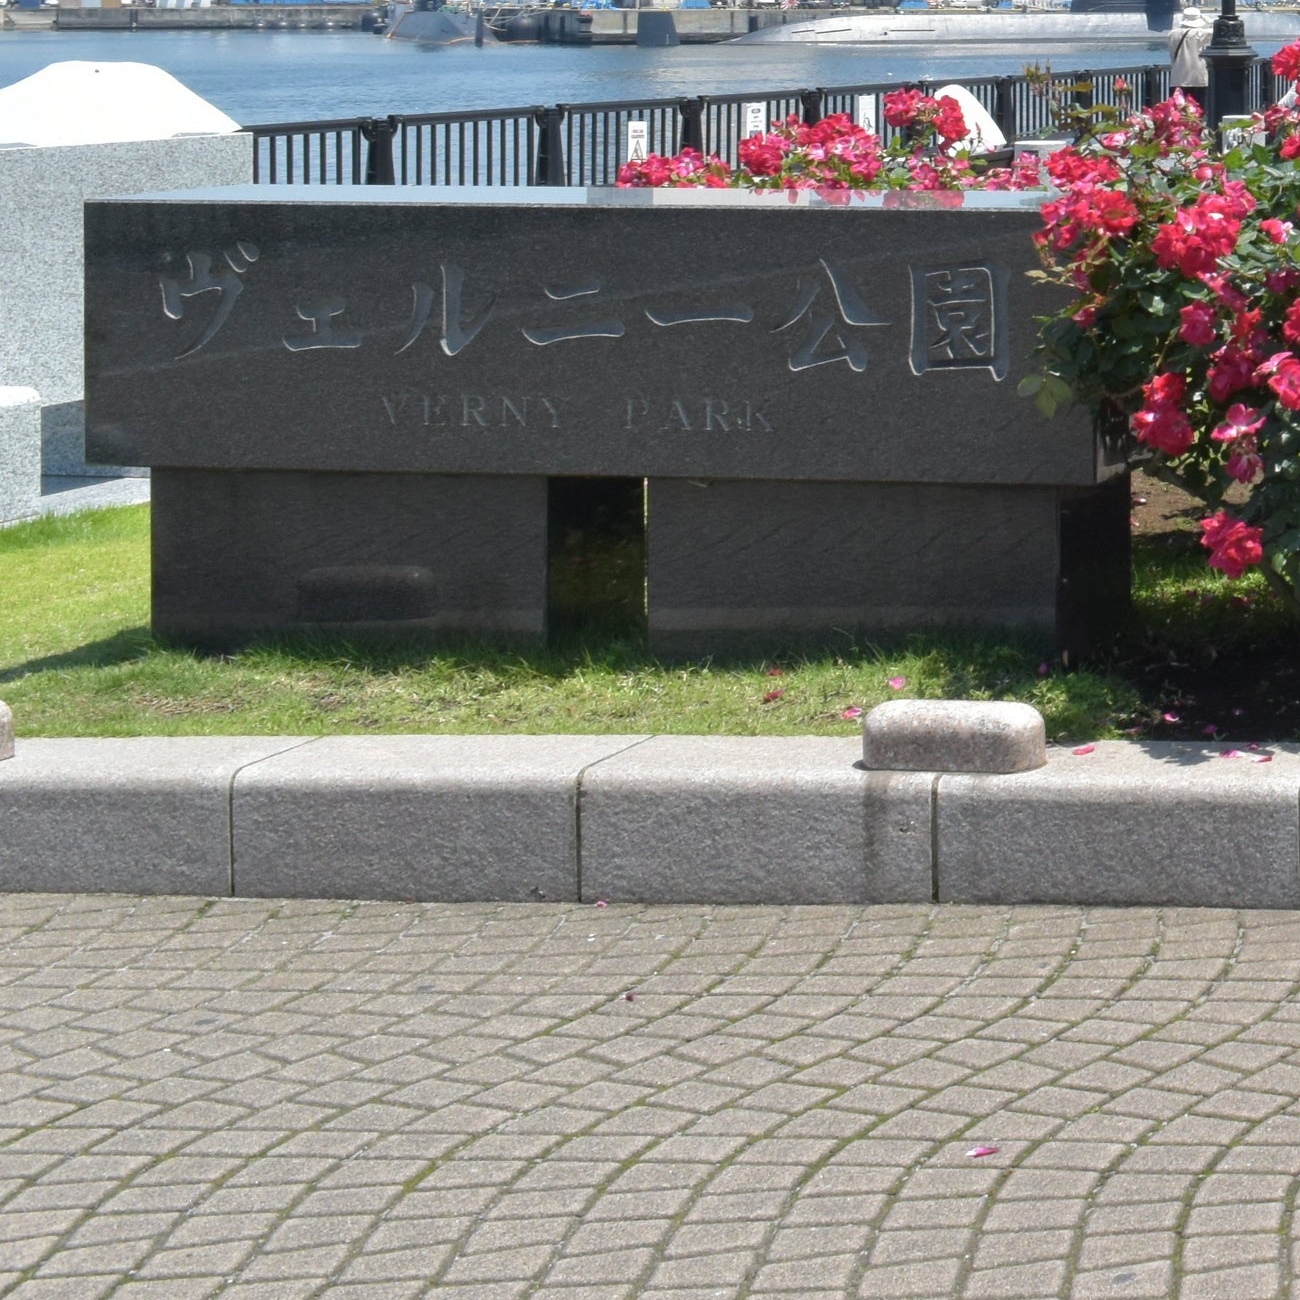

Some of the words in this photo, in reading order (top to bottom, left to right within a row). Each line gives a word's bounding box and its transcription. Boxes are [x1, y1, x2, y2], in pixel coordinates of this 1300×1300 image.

[158, 240, 1011, 382] ヴェルニー公園
[381, 394, 570, 429] VERNY
[622, 397, 775, 432] PARK
